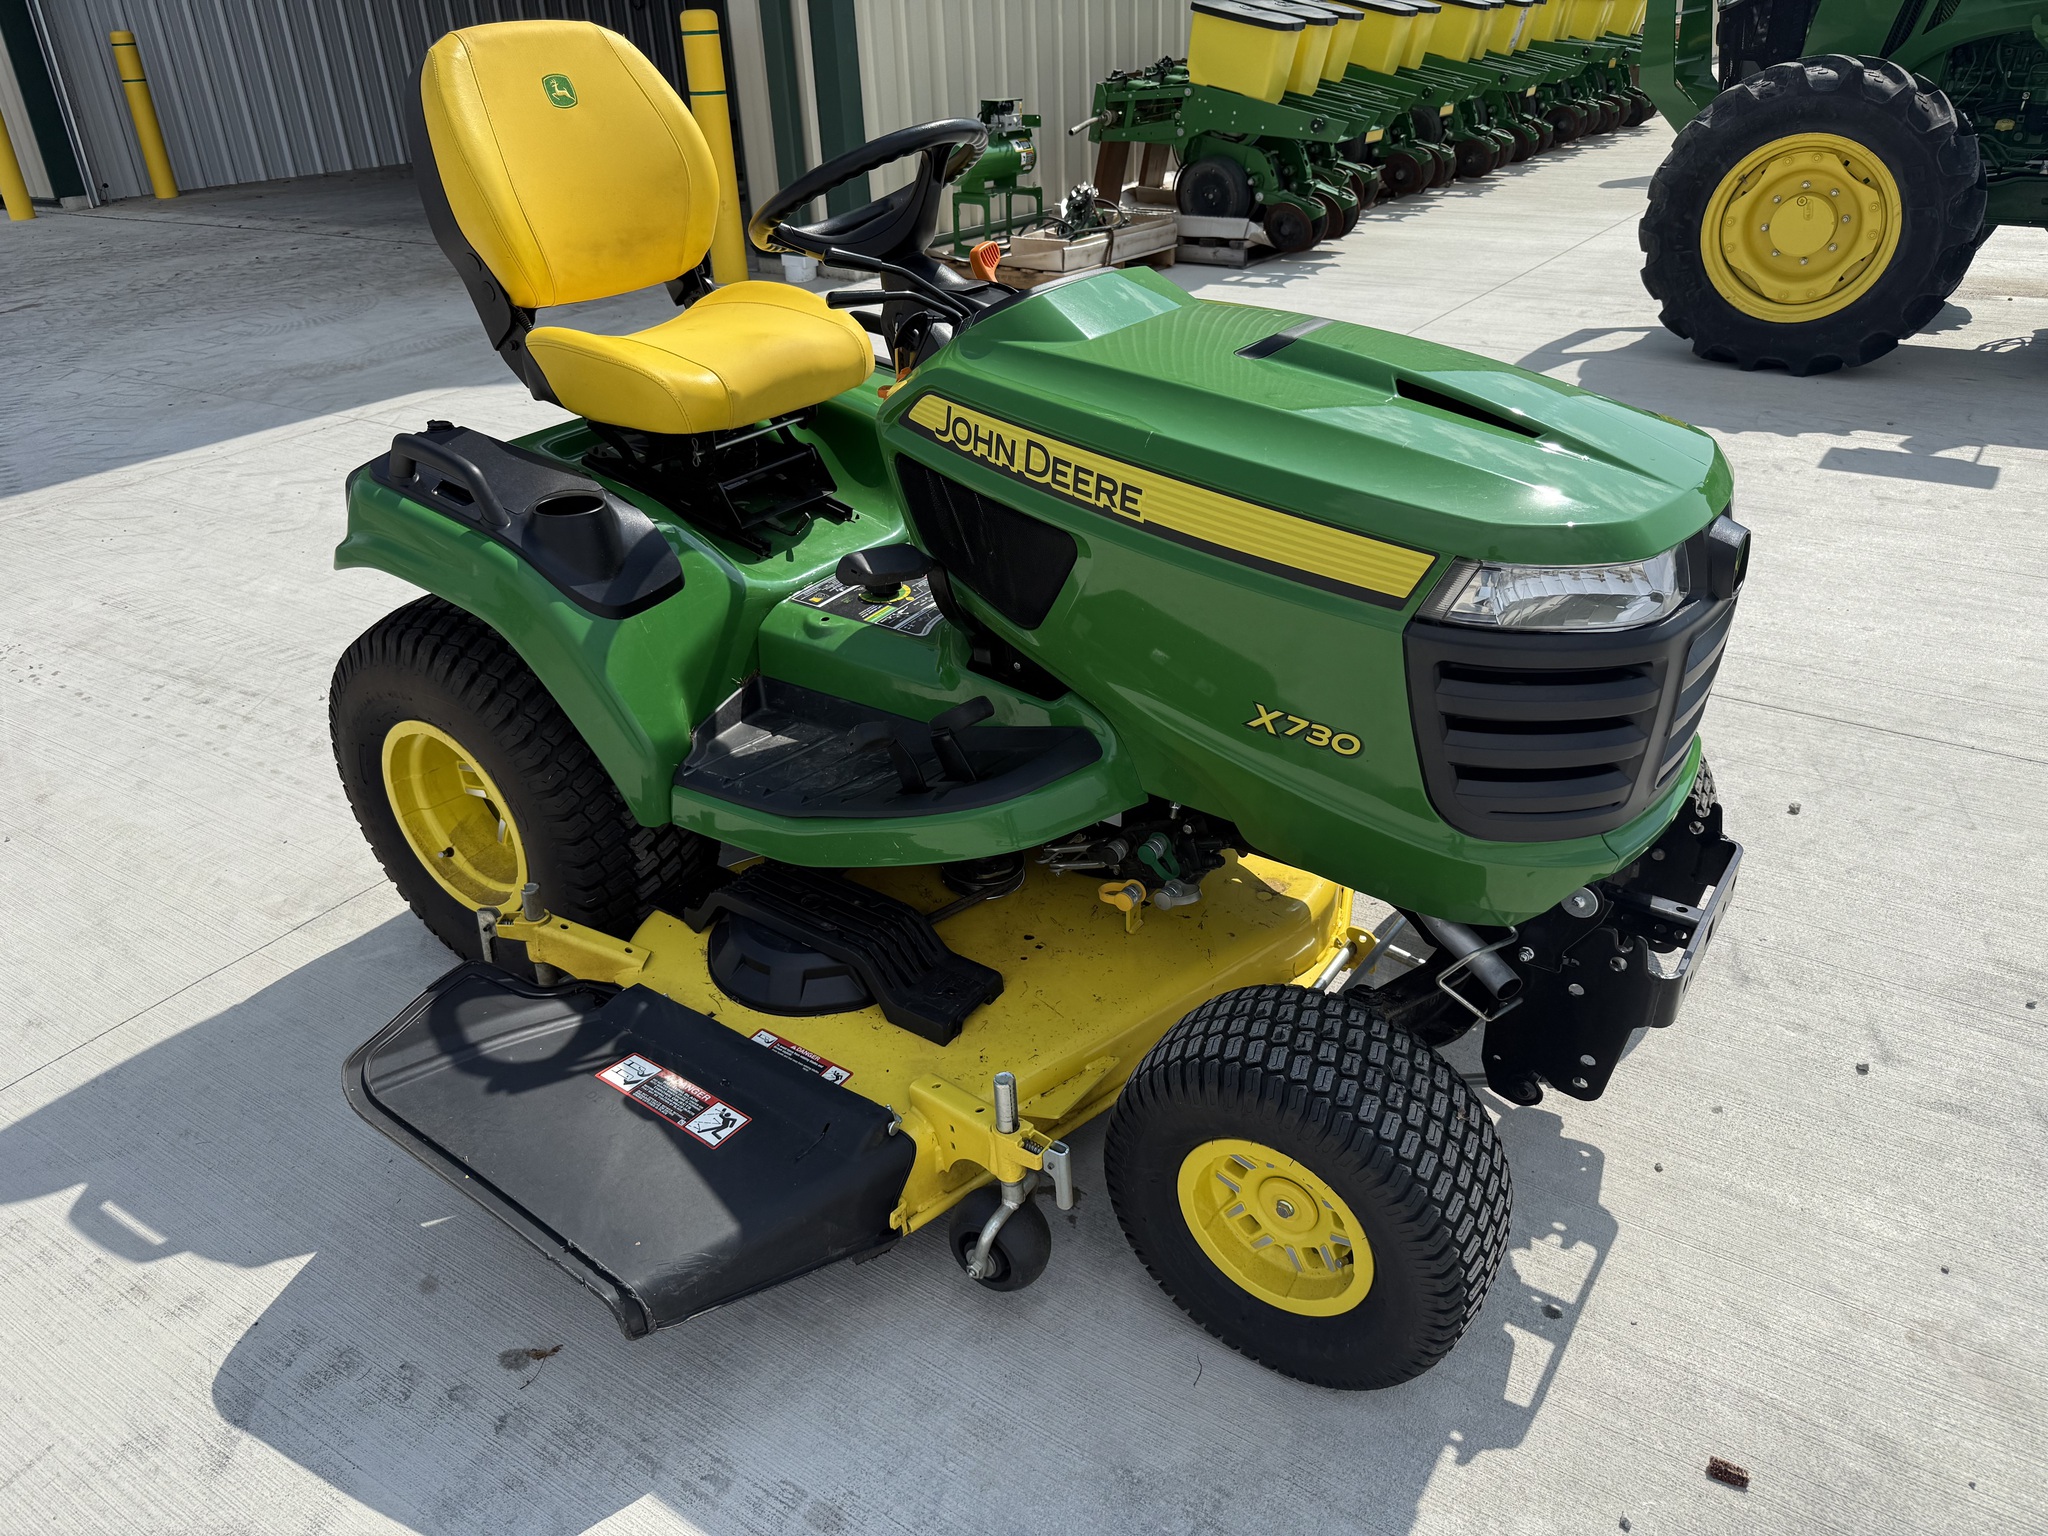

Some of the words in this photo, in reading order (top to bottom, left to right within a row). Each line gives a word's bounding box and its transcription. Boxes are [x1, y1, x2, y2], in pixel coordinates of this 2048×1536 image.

[935, 405, 1017, 468] JOHN
[1024, 438, 1143, 518] DEERE
[1245, 702, 1362, 756] X730
[795, 1046, 821, 1062] DANGER
